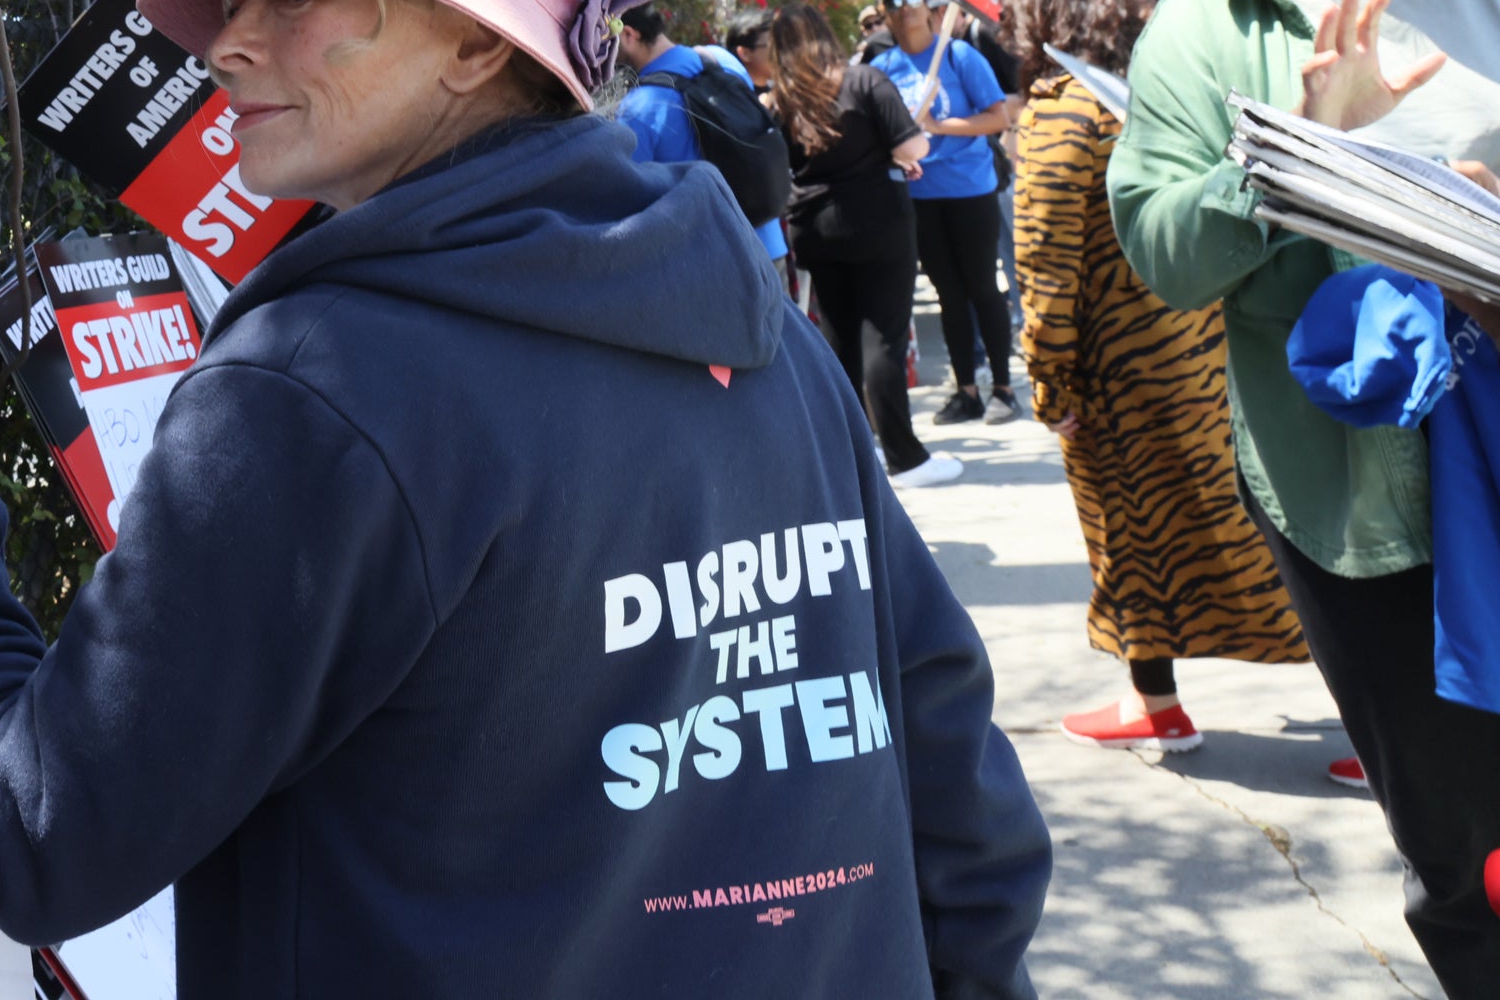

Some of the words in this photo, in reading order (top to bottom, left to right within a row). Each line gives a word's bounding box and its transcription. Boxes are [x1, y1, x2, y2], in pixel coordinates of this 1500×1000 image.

[37, 29, 137, 133] WRITERS
[125, 55, 210, 149] AMERIC
[129, 55, 160, 88] OF
[50, 257, 129, 294] WRITERS
[126, 253, 170, 284] GUILD
[116, 289, 135, 310] ON
[72, 304, 197, 379] STRIKE!
[604, 518, 873, 654] DISRUPT
[710, 615, 799, 685] THE
[601, 667, 893, 811] SYSTEM
[644, 861, 875, 914] WWW.MARIANNE2024.COM
